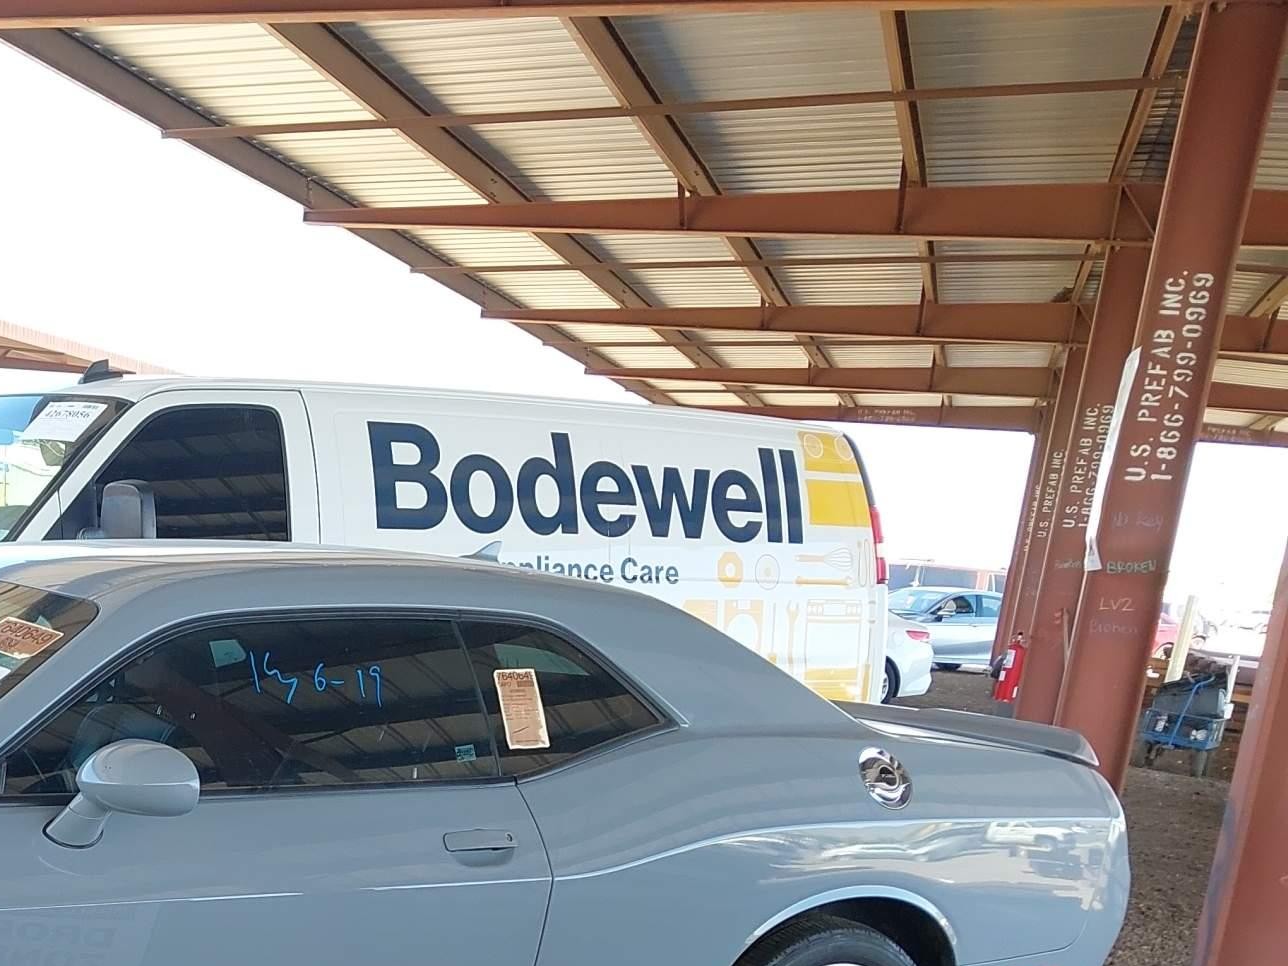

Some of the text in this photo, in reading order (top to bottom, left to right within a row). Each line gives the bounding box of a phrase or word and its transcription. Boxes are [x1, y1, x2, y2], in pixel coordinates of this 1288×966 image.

[1124, 269, 1189, 482] U.S. PREFAB INC.
[1150, 272, 1215, 481] 1-866-799-0969
[367, 420, 804, 545] Bodewell
[1042, 472, 1059, 514] PREFAB
[1062, 402, 1101, 529] U.S. PREFAB INC.
[620, 557, 679, 584] Care
[1107, 559, 1157, 574] BROKEN
